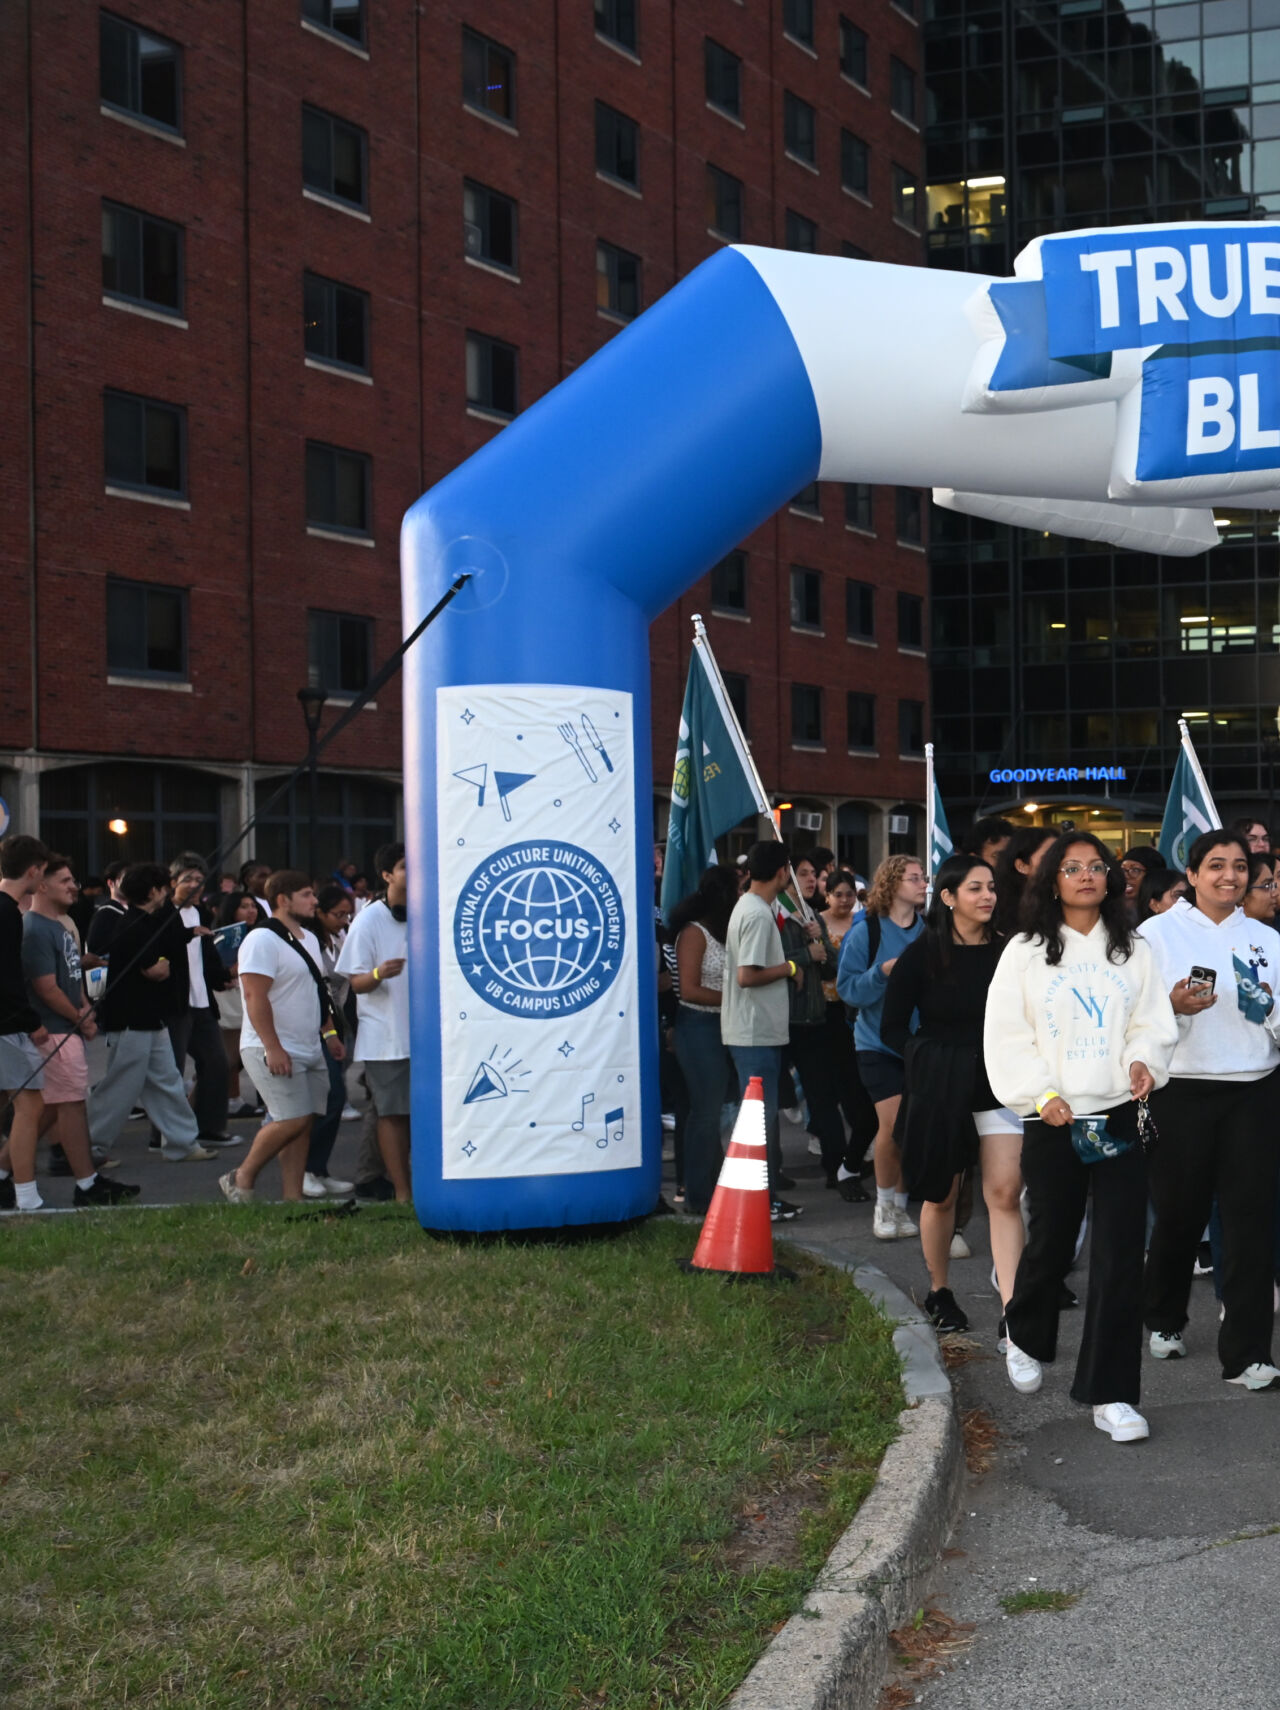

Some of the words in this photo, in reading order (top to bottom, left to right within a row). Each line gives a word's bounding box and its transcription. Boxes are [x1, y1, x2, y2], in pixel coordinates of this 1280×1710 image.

[989, 767, 1079, 783] GOODYEAR
[1085, 766, 1126, 780] HALL
[460, 893, 481, 954] FESTIVAL
[474, 873, 492, 892] OF
[489, 847, 550, 877] CULTURE
[553, 848, 602, 884] UNITING
[598, 882, 621, 950] STUDENTS
[494, 918, 590, 941] FOCUS
[485, 980, 504, 998] UB
[502, 991, 561, 1011] CAMPUS
[562, 977, 600, 1007] LIVING
[1069, 986, 1107, 1028] NY
[1075, 1036, 1105, 1047] CLUB
